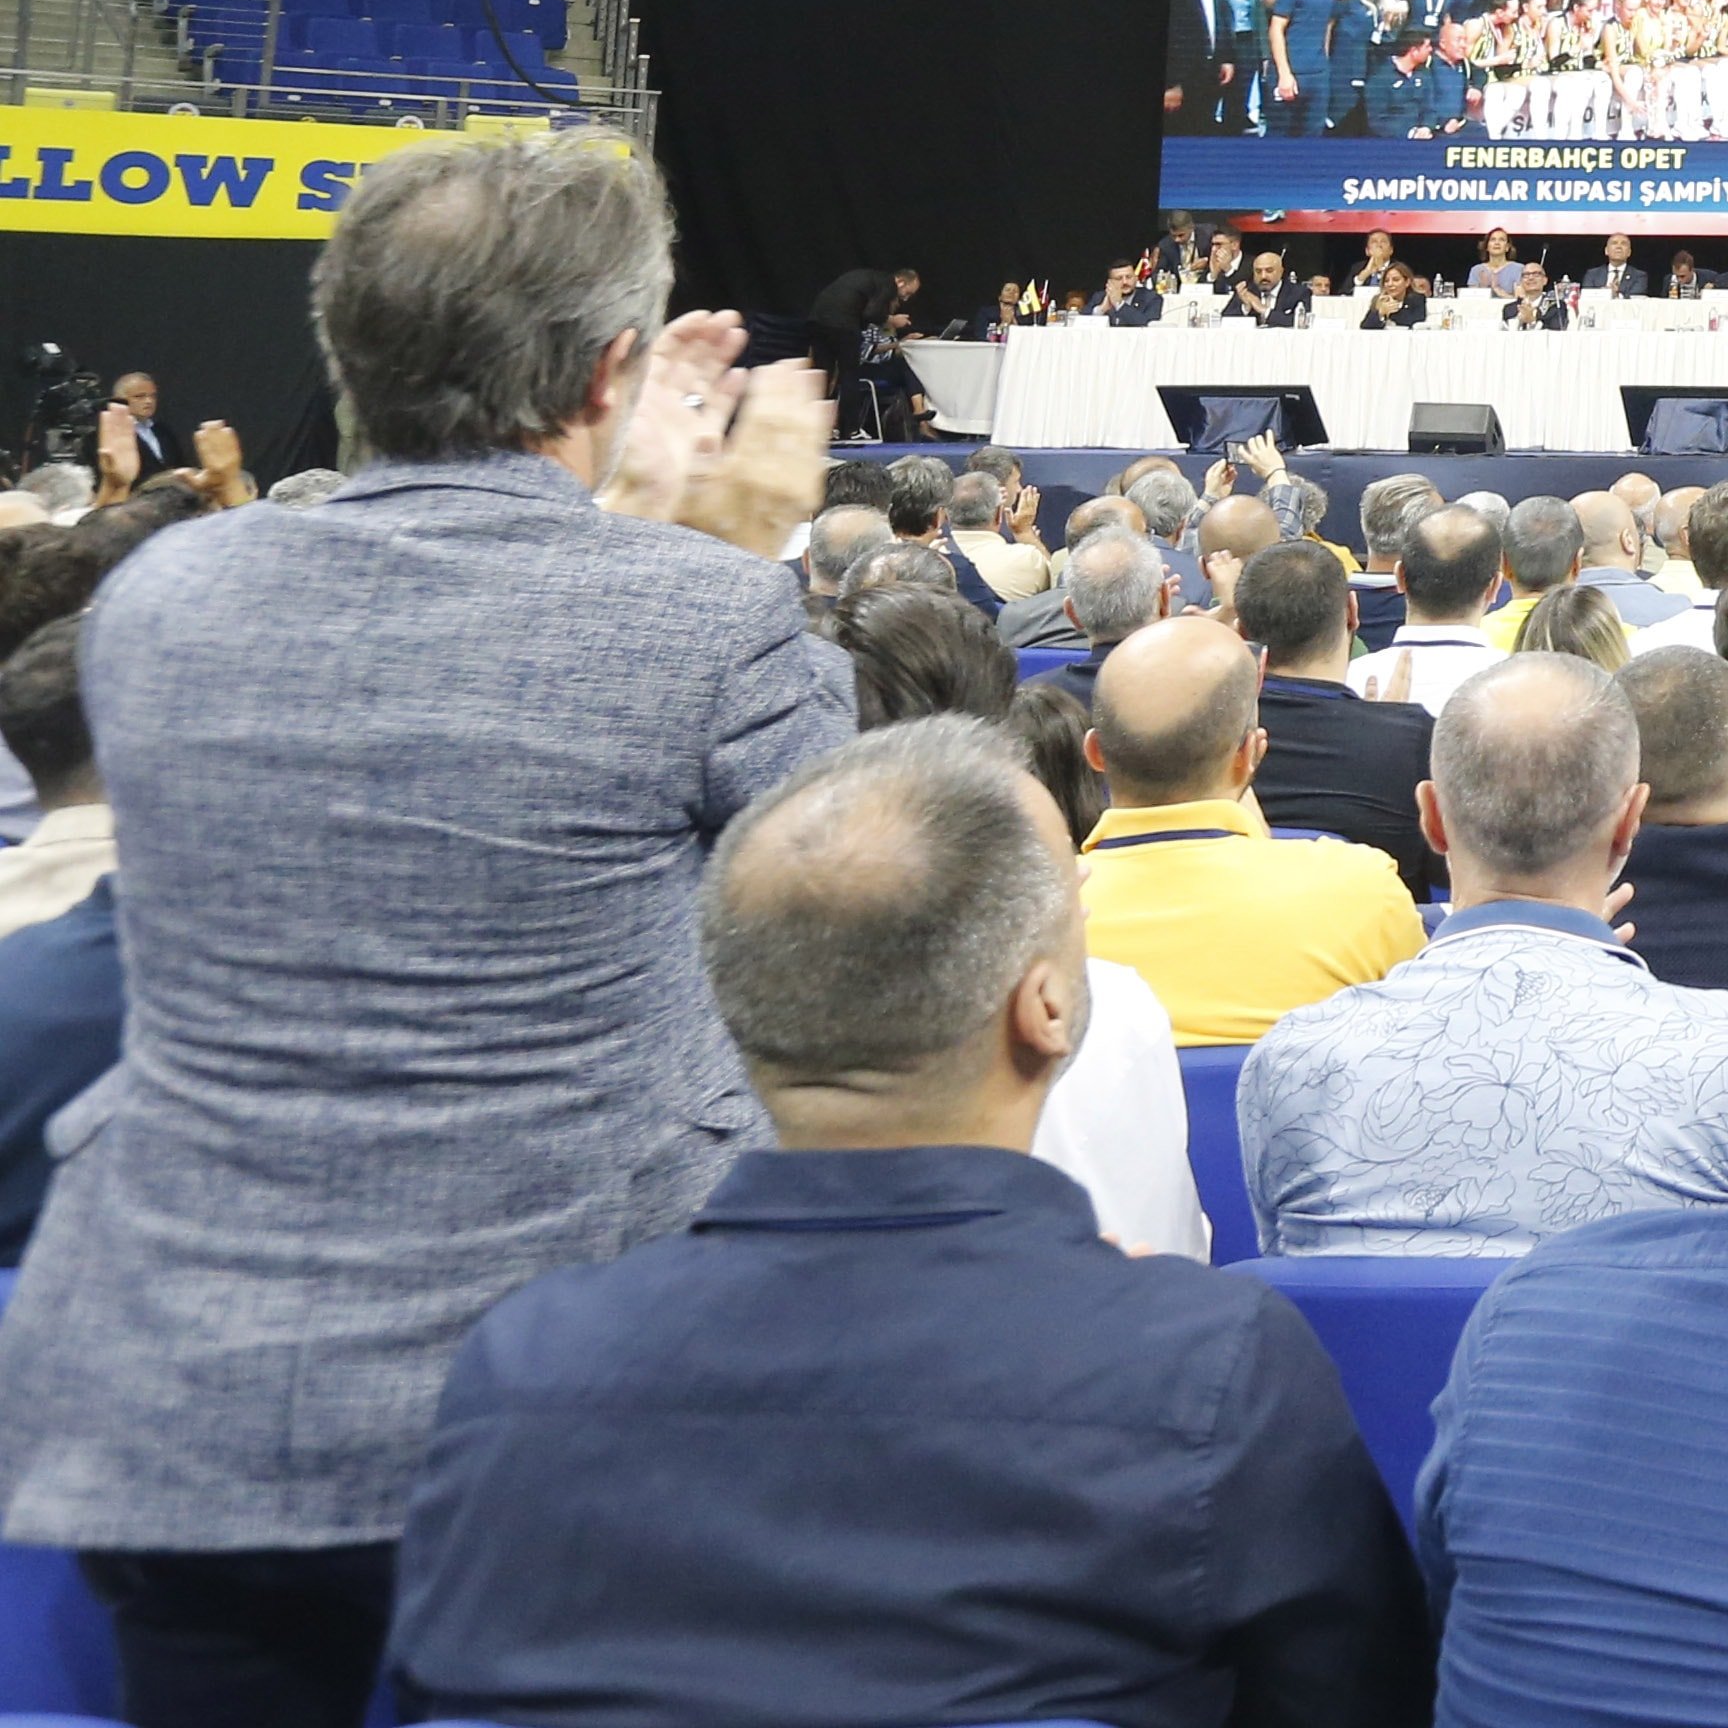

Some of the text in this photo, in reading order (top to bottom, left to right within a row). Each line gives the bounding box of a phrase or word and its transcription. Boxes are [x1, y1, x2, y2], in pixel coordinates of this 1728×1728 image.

[1445, 146, 1687, 173] FENERBAHÇE OPET
[296, 158, 375, 212] S
[1342, 175, 1529, 205] ŞAMPİYONLAR
[1536, 179, 1632, 202] KUPASI
